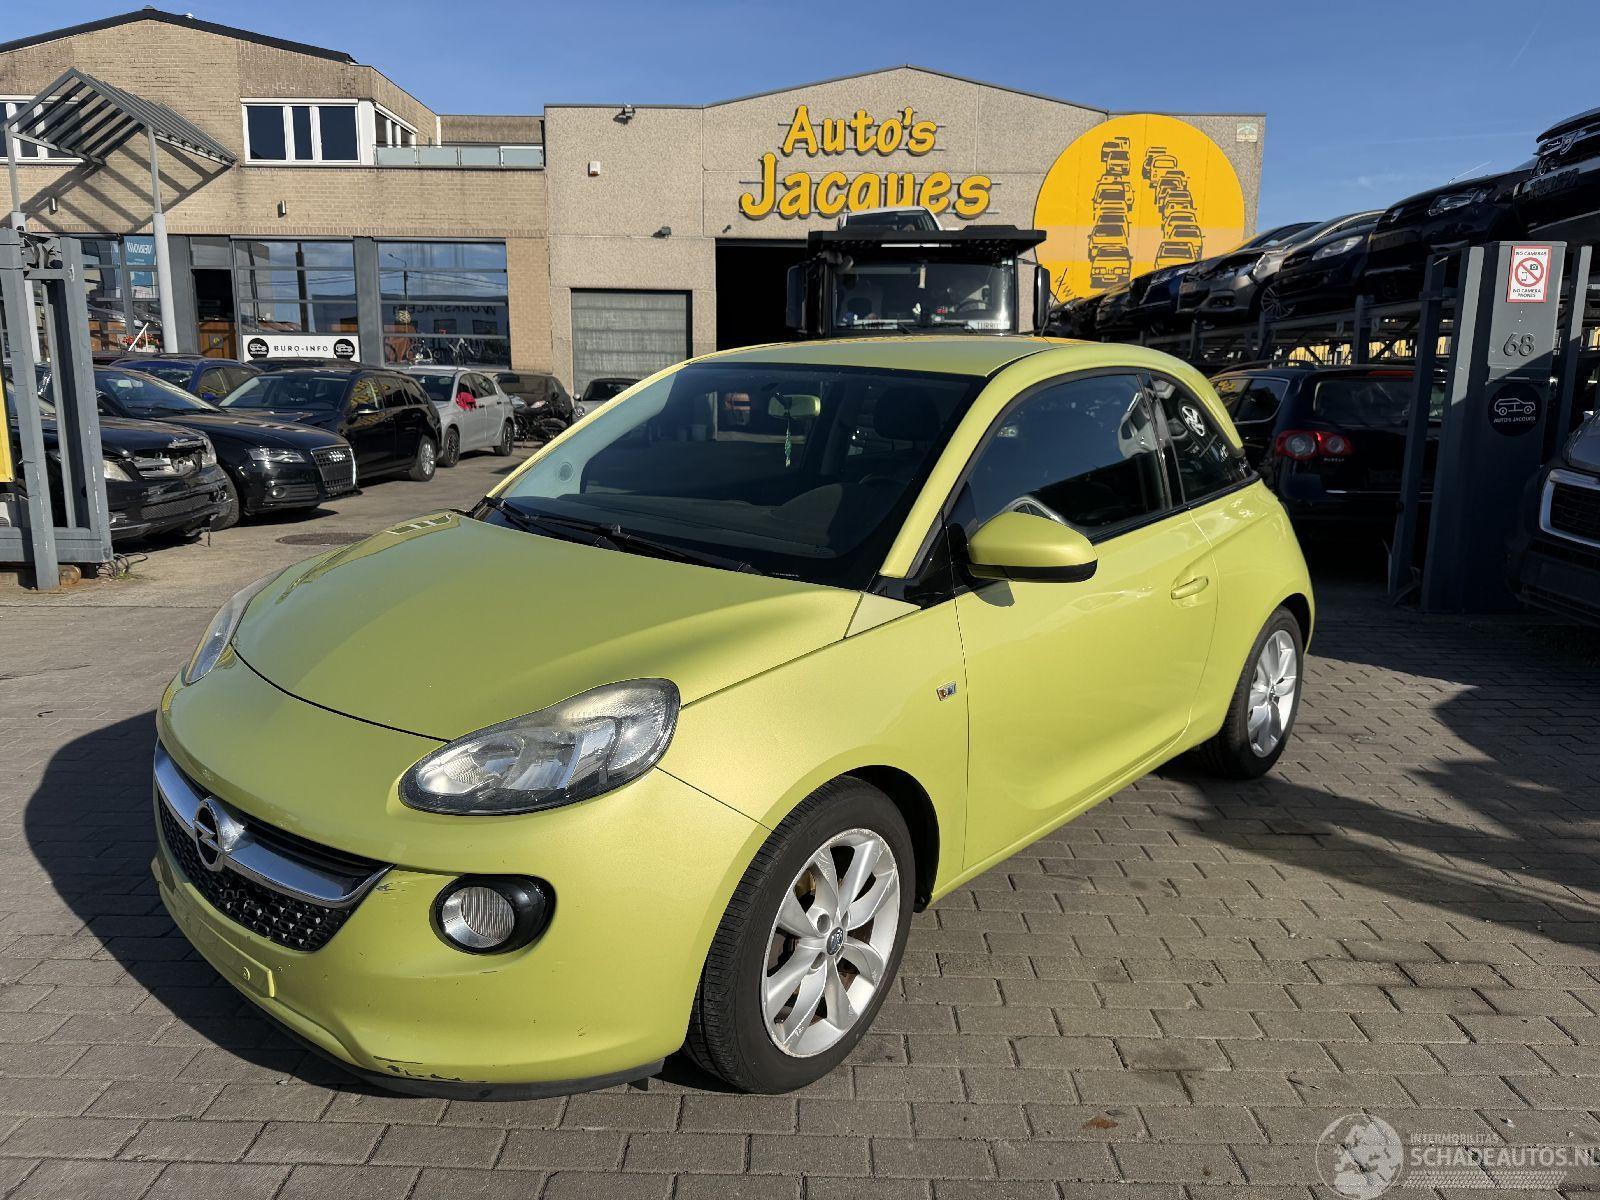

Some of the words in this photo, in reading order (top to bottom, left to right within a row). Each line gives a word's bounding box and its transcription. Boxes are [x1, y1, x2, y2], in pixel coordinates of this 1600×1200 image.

[782, 104, 938, 155] Auto's
[740, 152, 992, 218] Jacques
[1503, 332, 1535, 356] 68
